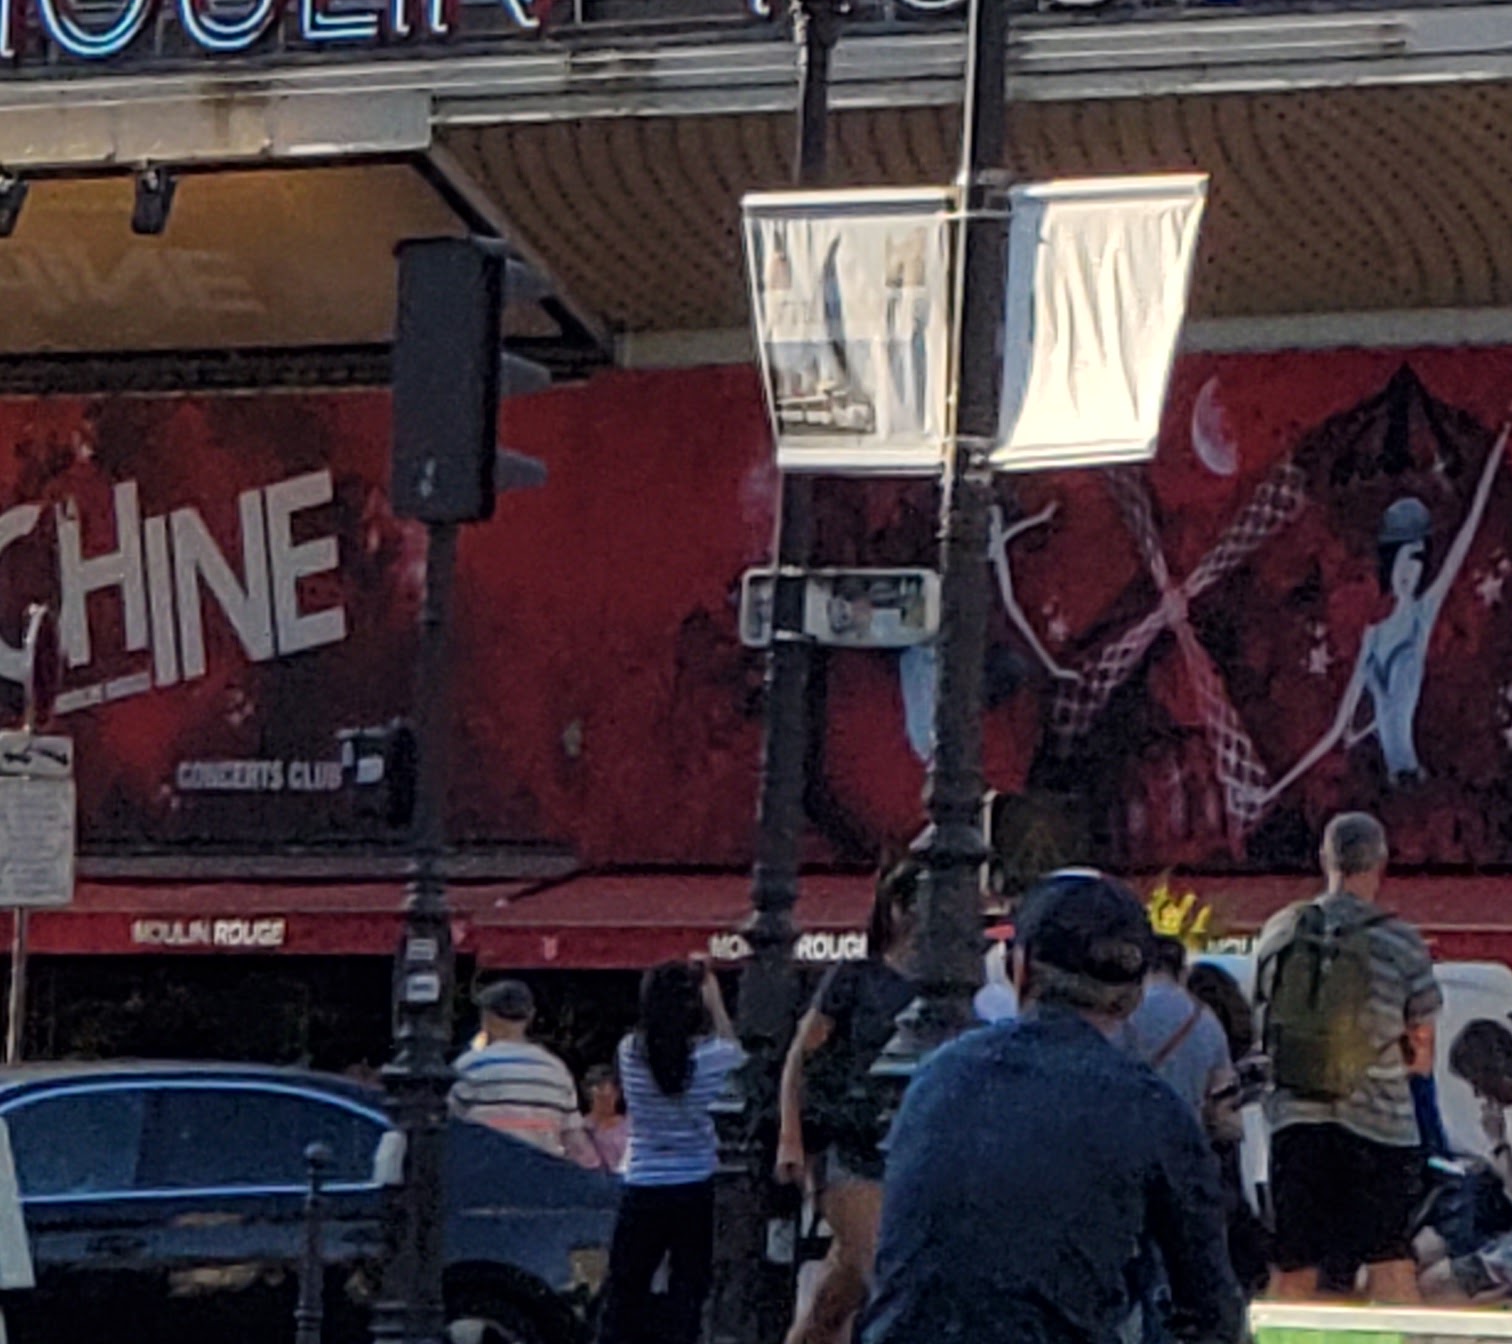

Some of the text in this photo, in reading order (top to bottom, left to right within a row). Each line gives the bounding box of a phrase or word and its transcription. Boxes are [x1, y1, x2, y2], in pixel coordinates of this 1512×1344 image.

[178, 759, 284, 791] CONCERTS
[132, 918, 286, 945] MOULIN ROUGE
